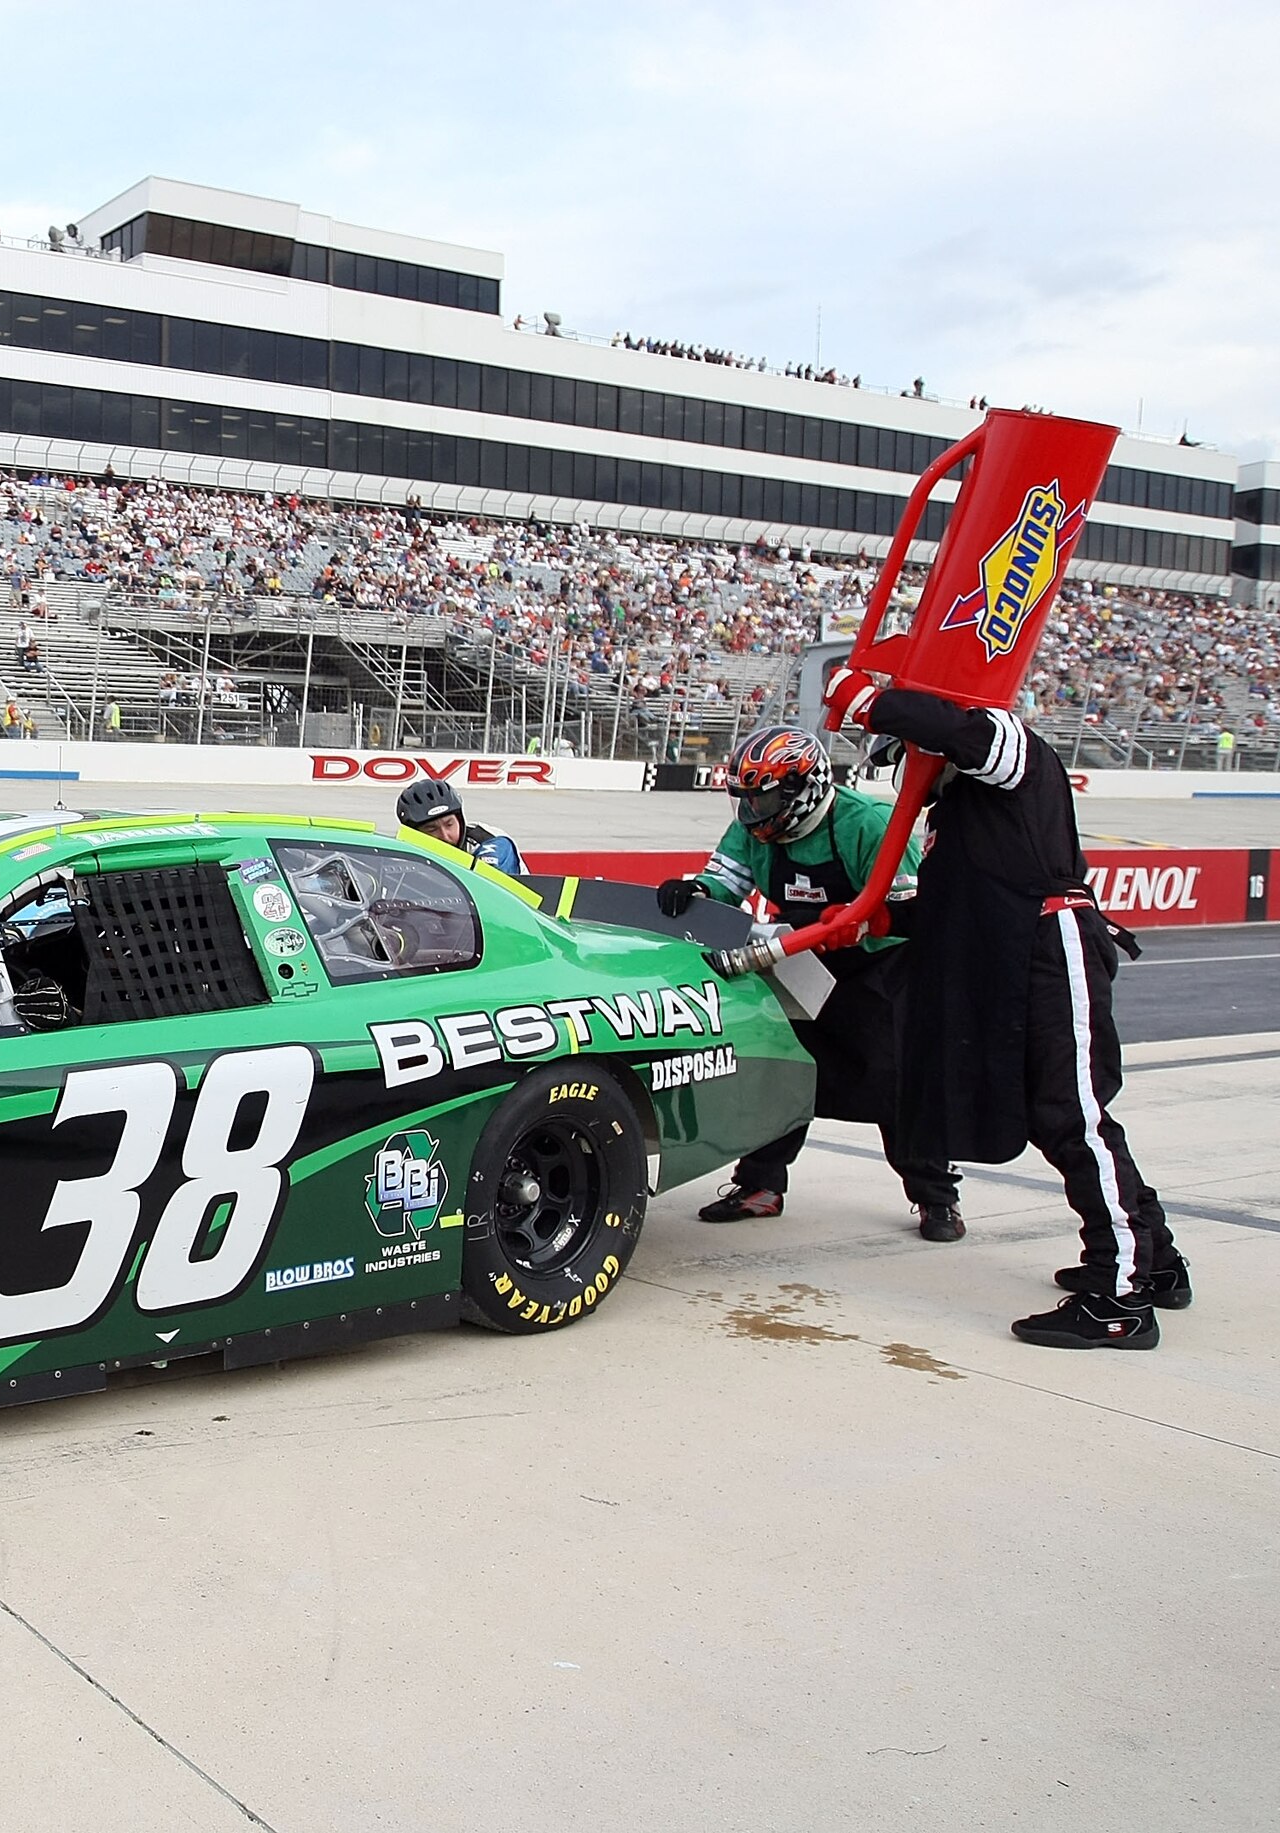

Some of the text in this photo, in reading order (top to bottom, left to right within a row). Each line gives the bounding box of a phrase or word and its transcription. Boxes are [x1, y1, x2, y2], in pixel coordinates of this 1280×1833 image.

[987, 495, 1056, 642] SUNOCO
[220, 693, 240, 704] 251
[311, 756, 554, 785] DOVER
[1250, 875, 1265, 898] 16
[371, 982, 724, 1090] BESTWAY
[650, 1045, 738, 1092] DISPOSAL
[548, 1082, 599, 1104] EAGLE
[365, 1250, 441, 1273] INDUSTRIES
[381, 1240, 427, 1257] WASTE
[265, 1256, 356, 1292] BLOW BROS
[494, 1254, 620, 1325] GOODYEAR
[1106, 1322, 1123, 1333] S
